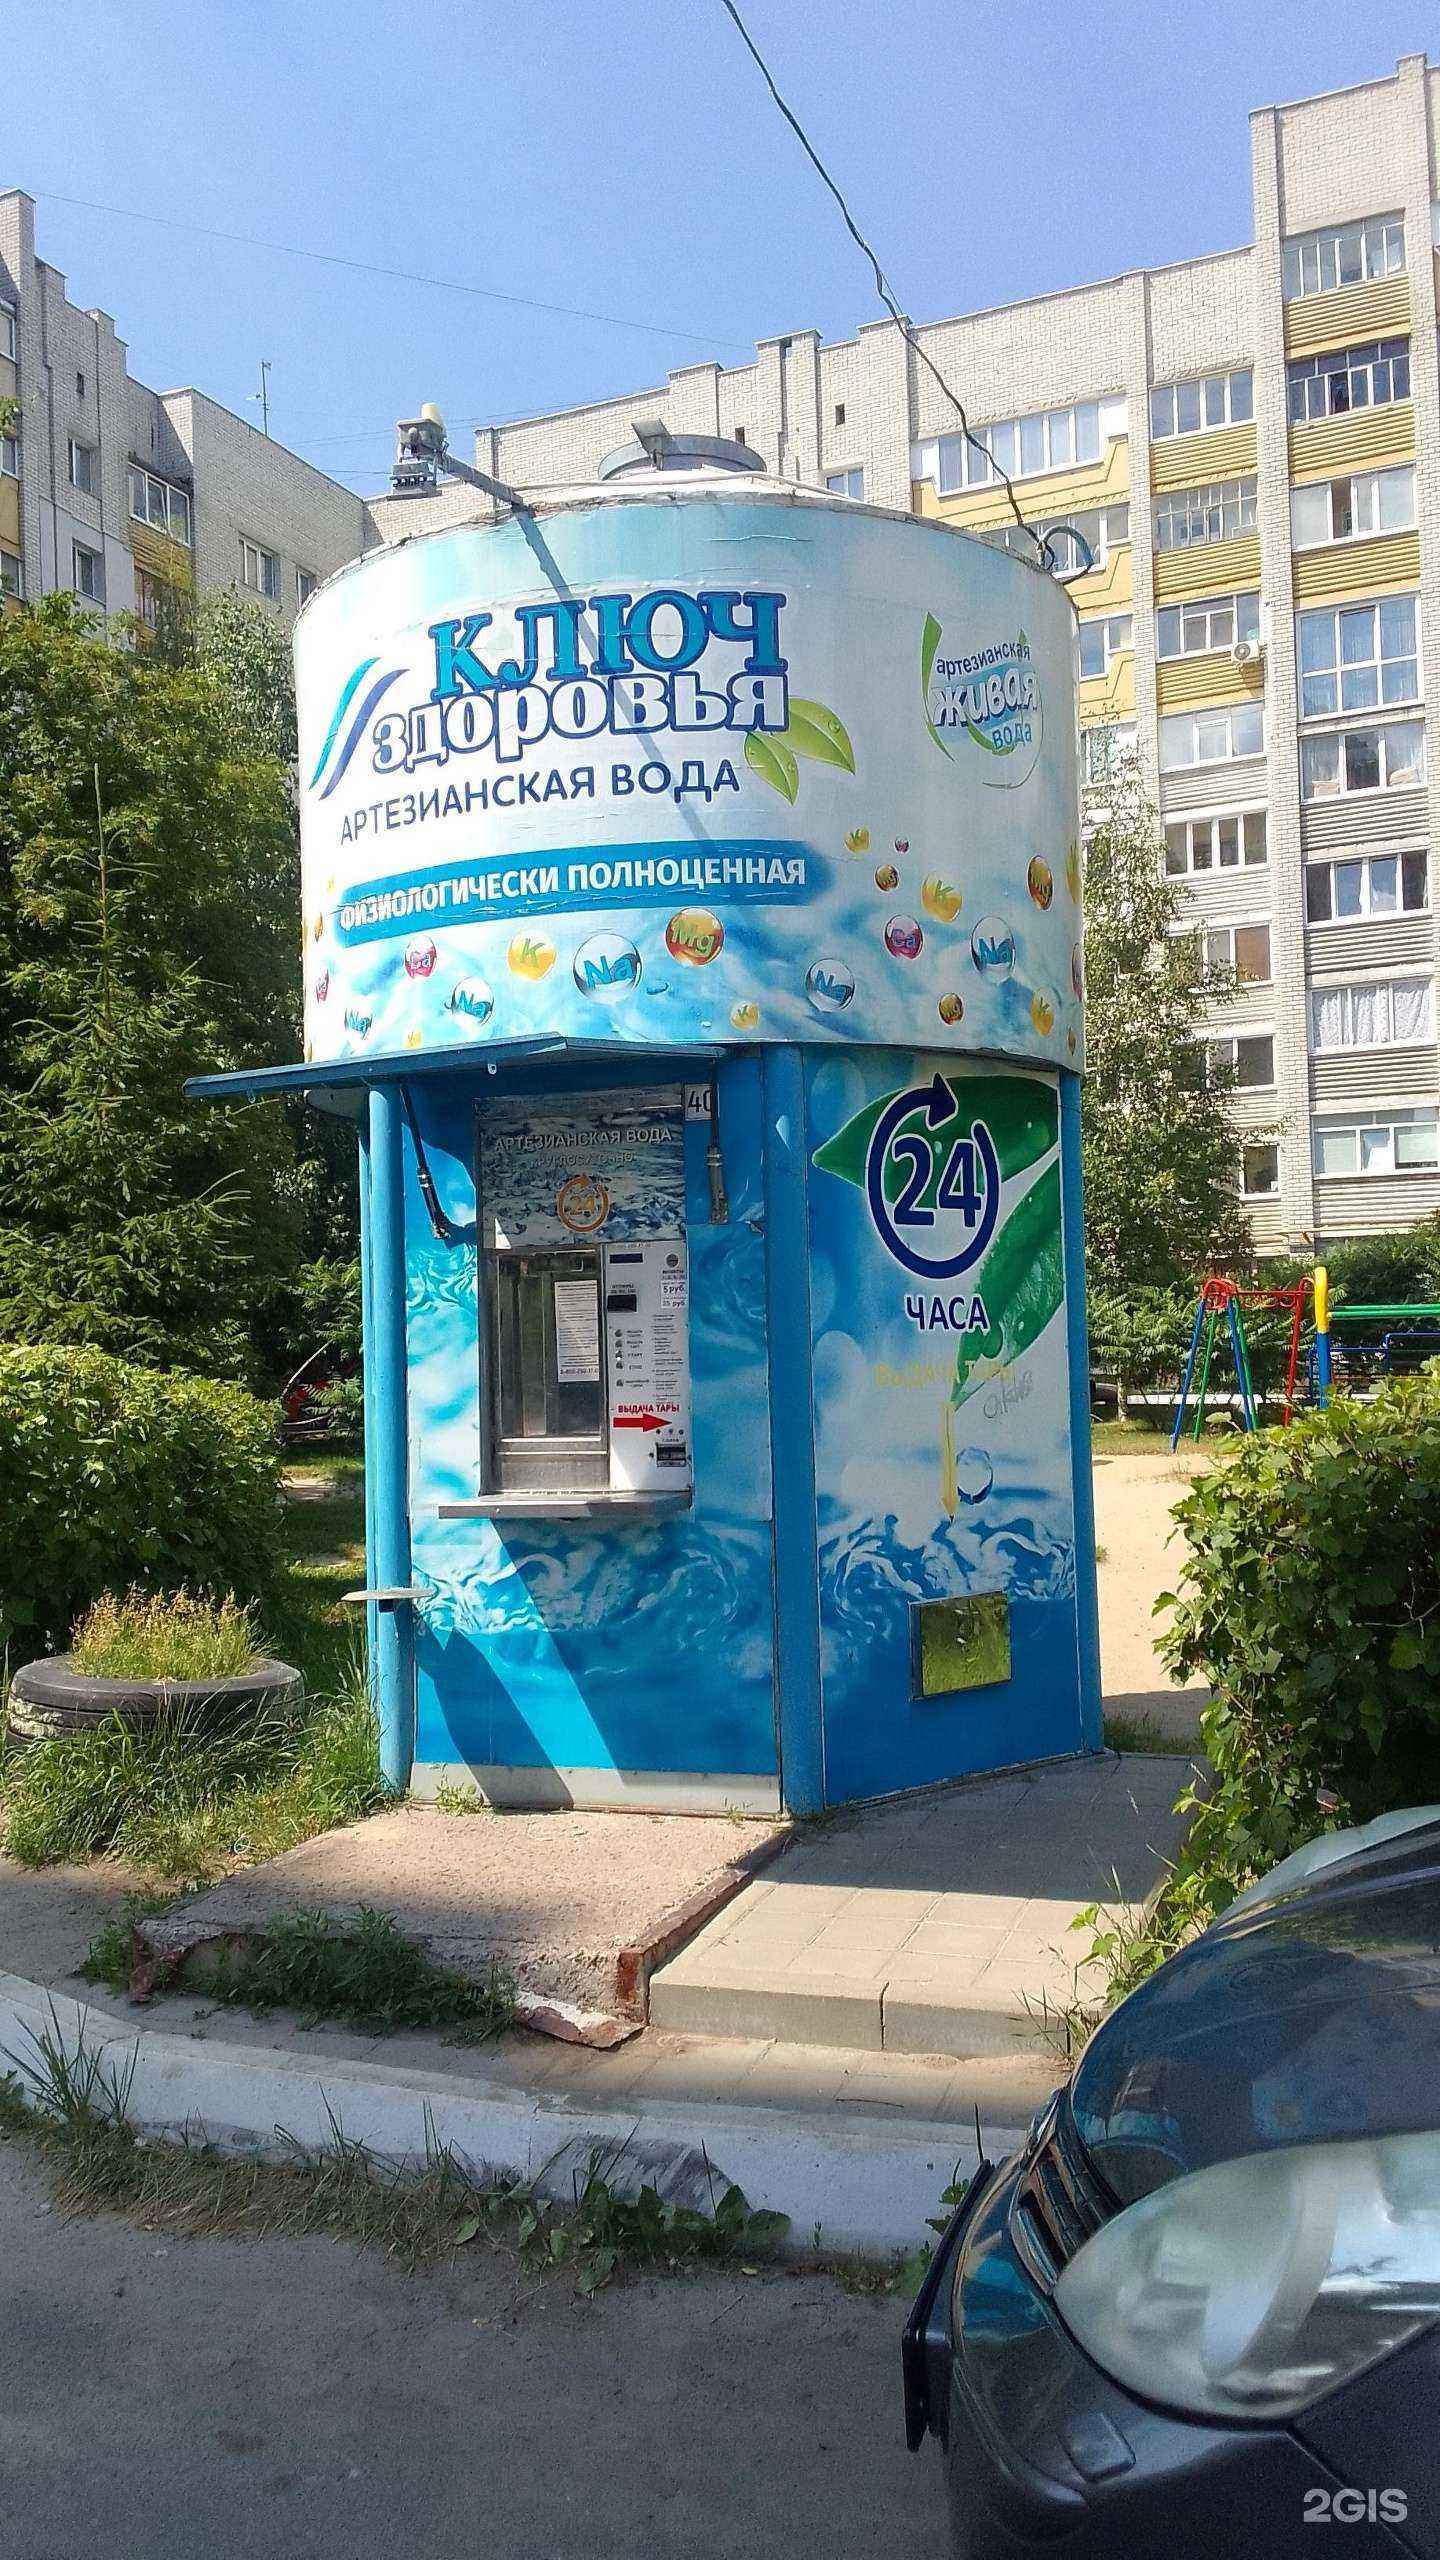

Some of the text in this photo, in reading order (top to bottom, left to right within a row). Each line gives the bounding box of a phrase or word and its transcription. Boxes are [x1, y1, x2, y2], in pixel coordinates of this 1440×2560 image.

[936, 643, 1031, 681] артезианская
[992, 722, 1032, 749] вода
[340, 759, 741, 845] АРТЕЗИАНСКАЯ ВОДА
[339, 858, 806, 930] ФИЗИОЛОГИЧЕСКИ ПОЛНОЦЕННАЯ
[520, 938, 545, 966] K
[671, 920, 715, 957] Mg
[583, 955, 635, 989] Na
[458, 990, 488, 1019] Na
[495, 1128, 673, 1151] АРТЕЗИАНСКАЯ ВОДА
[893, 1137, 982, 1228] 24
[906, 1296, 988, 1330] ЧАСА
[618, 1404, 680, 1414] ВЫДАЧА ТАРЫ
